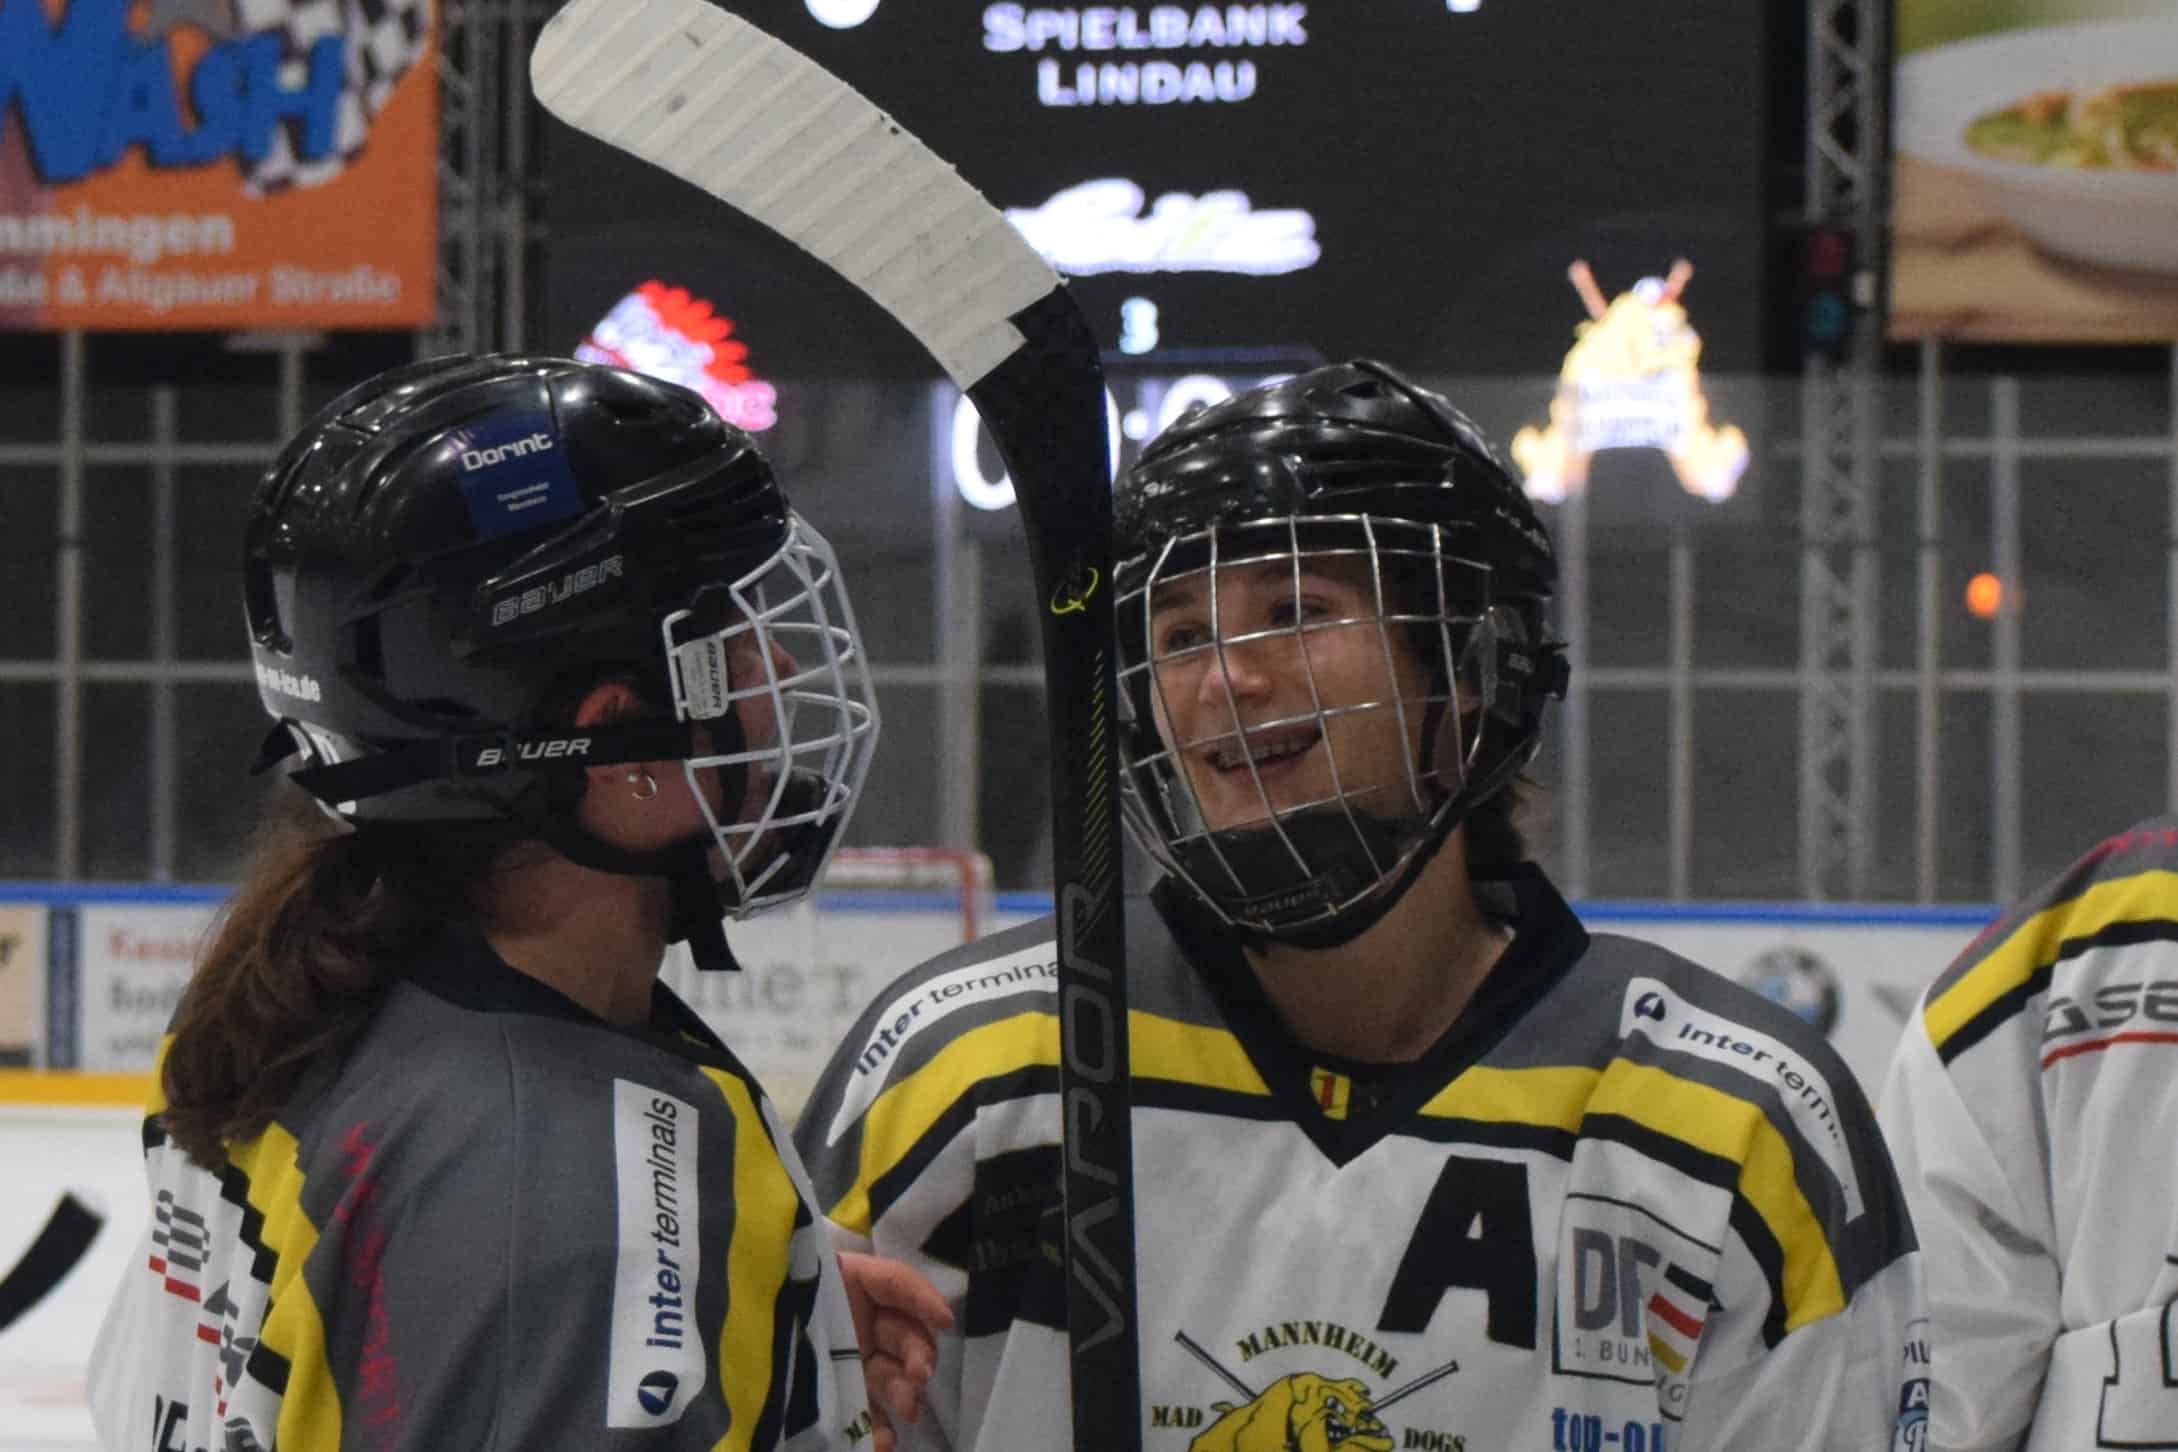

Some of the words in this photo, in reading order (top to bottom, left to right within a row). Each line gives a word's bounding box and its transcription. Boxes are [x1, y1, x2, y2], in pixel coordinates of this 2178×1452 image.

[983, 3, 1307, 51] SPIELBANK
[1037, 56, 1257, 106] LINDAU
[476, 738, 592, 768] BUER
[1376, 1154, 1538, 1351] A
[1236, 1320, 1399, 1380] MANNHEIM
[1151, 1404, 1204, 1428] MAD
